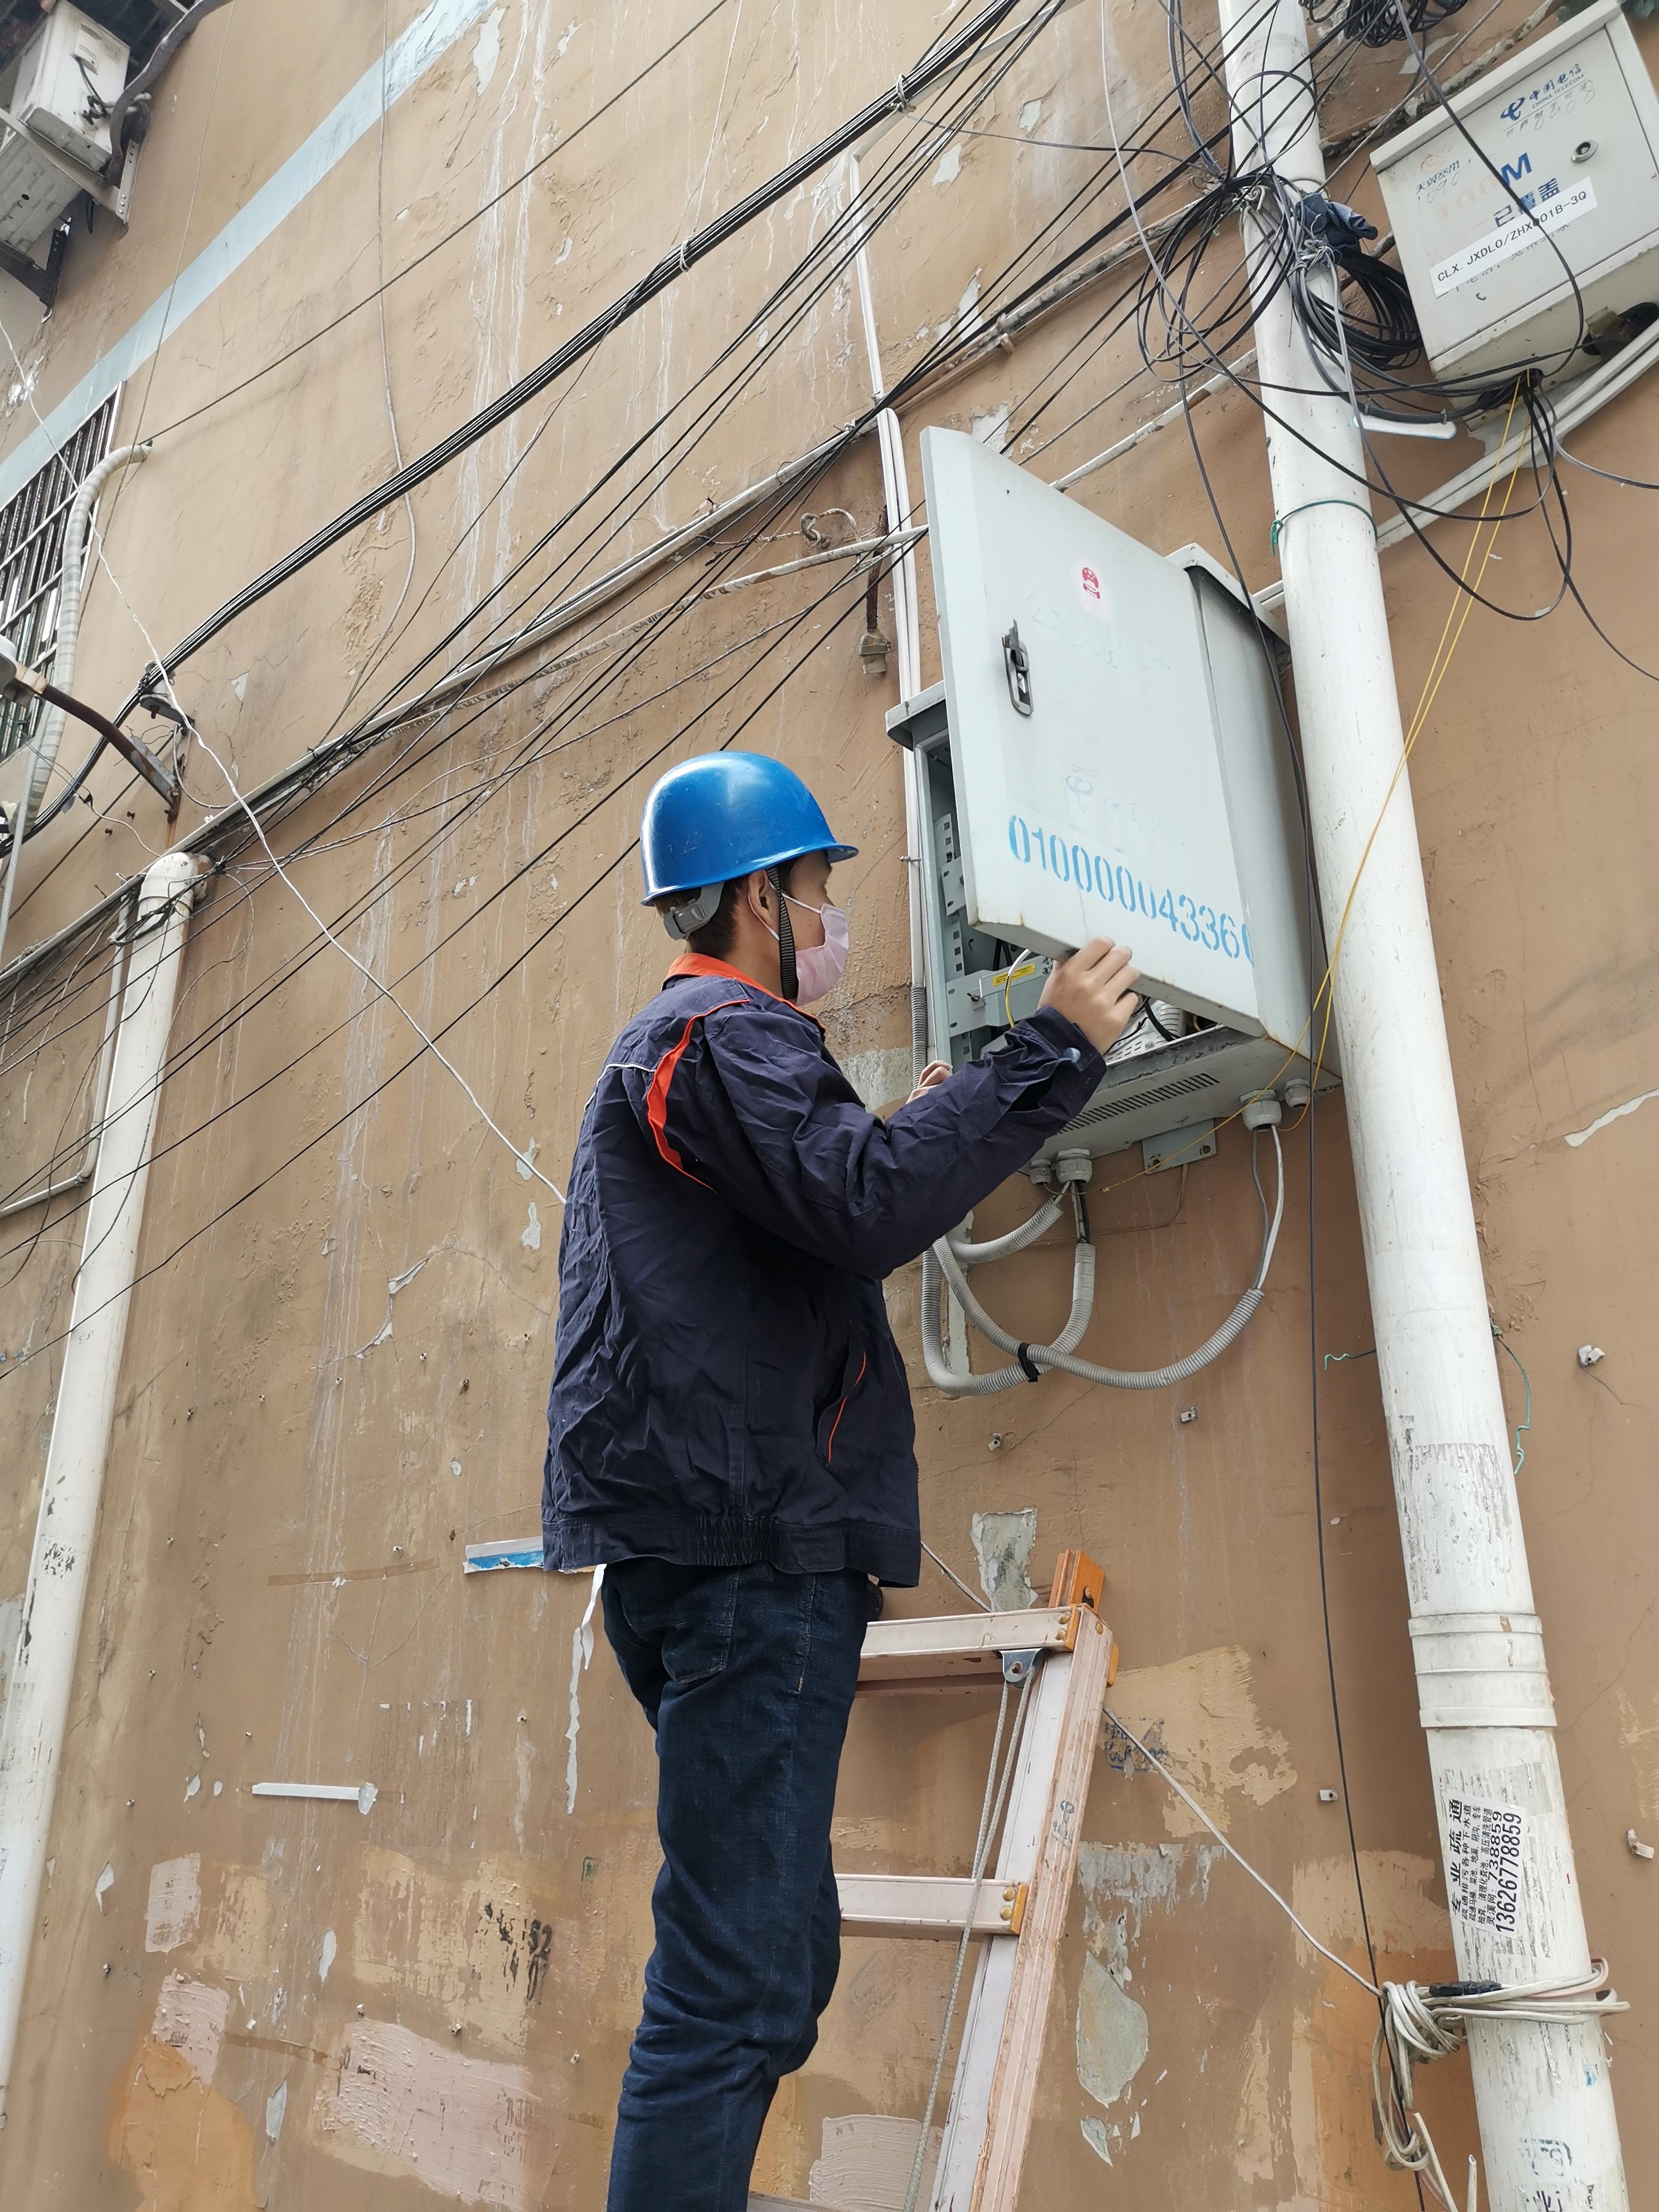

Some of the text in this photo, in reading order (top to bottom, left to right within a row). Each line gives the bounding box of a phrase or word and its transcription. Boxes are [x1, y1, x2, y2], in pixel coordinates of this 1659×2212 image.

[1449, 1798, 1462, 1916] 专业疏通
[1461, 1804, 1472, 1920] 疏通排污各种下水道
[1495, 1812, 1522, 1932] 13626778859
